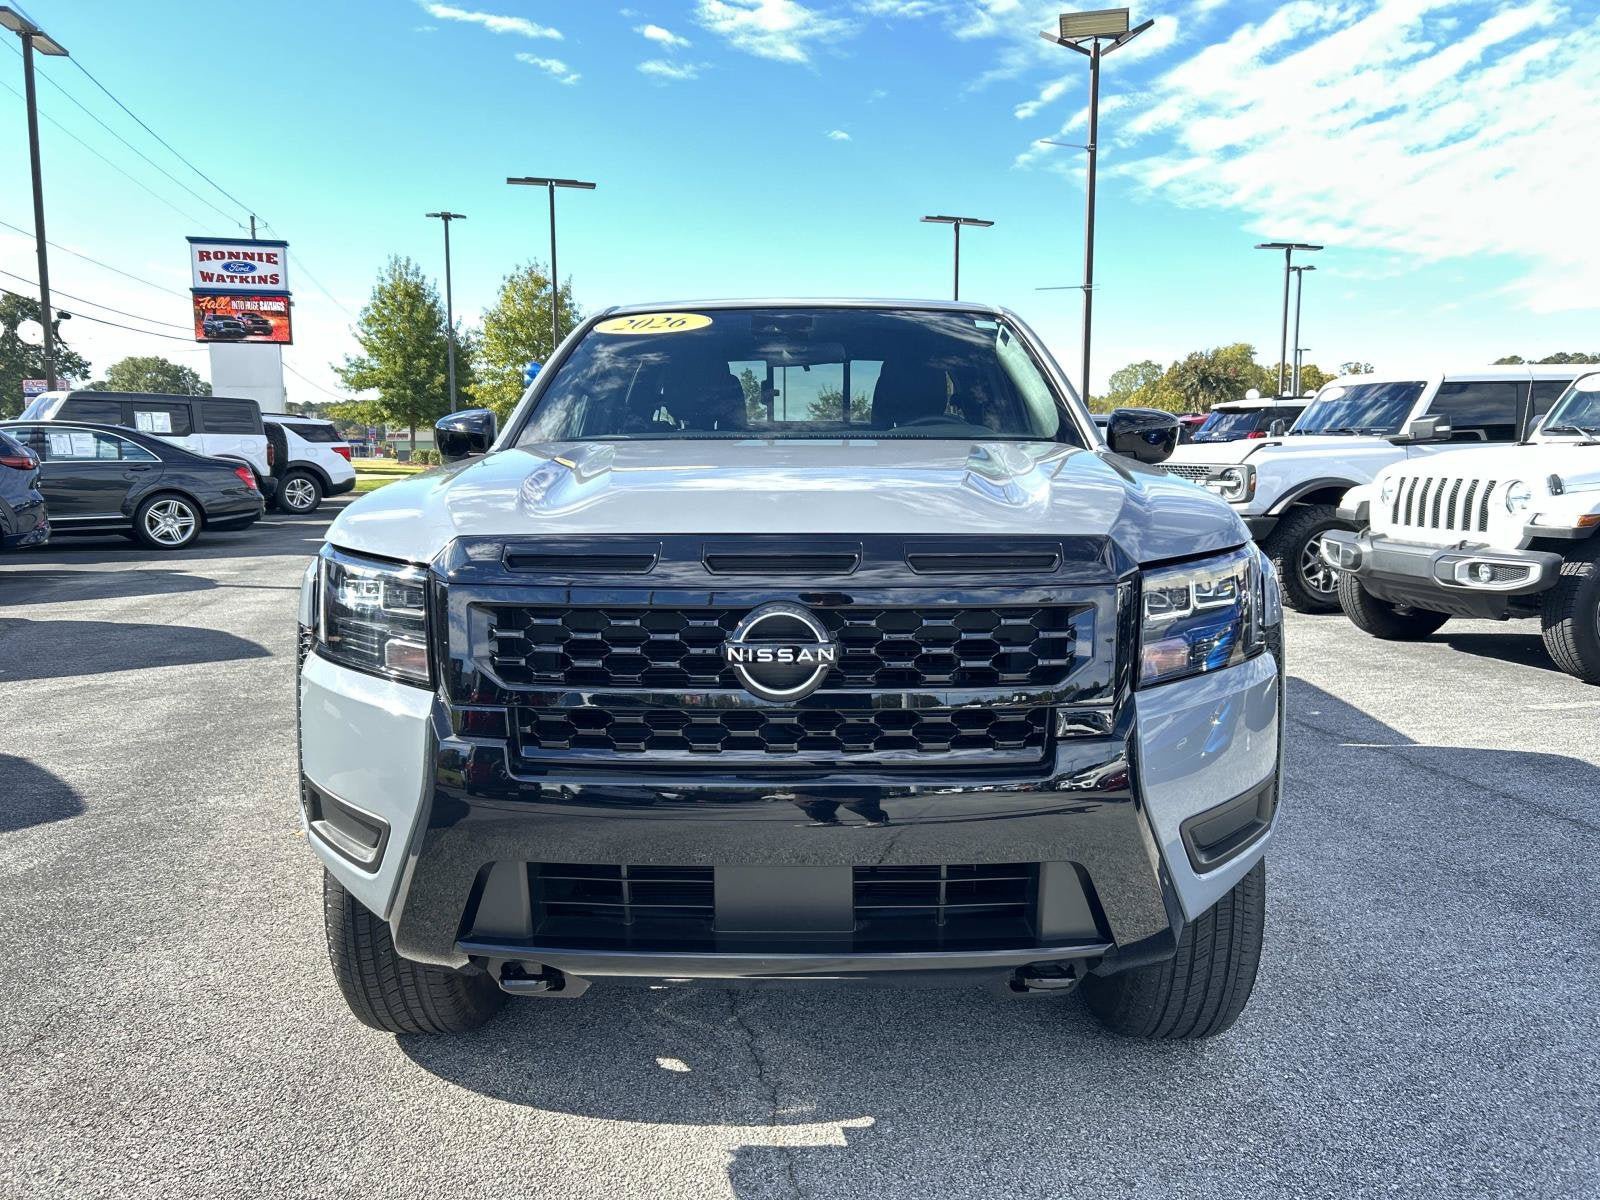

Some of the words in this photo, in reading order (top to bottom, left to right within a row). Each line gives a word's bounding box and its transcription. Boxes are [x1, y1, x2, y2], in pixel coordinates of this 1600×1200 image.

[198, 250, 278, 265] RONNIE
[229, 263, 250, 272] Ford
[199, 271, 280, 285] WATKINS
[260, 301, 285, 311] SAVINGS
[612, 317, 688, 331] 2026
[727, 647, 834, 662] NISSAN
